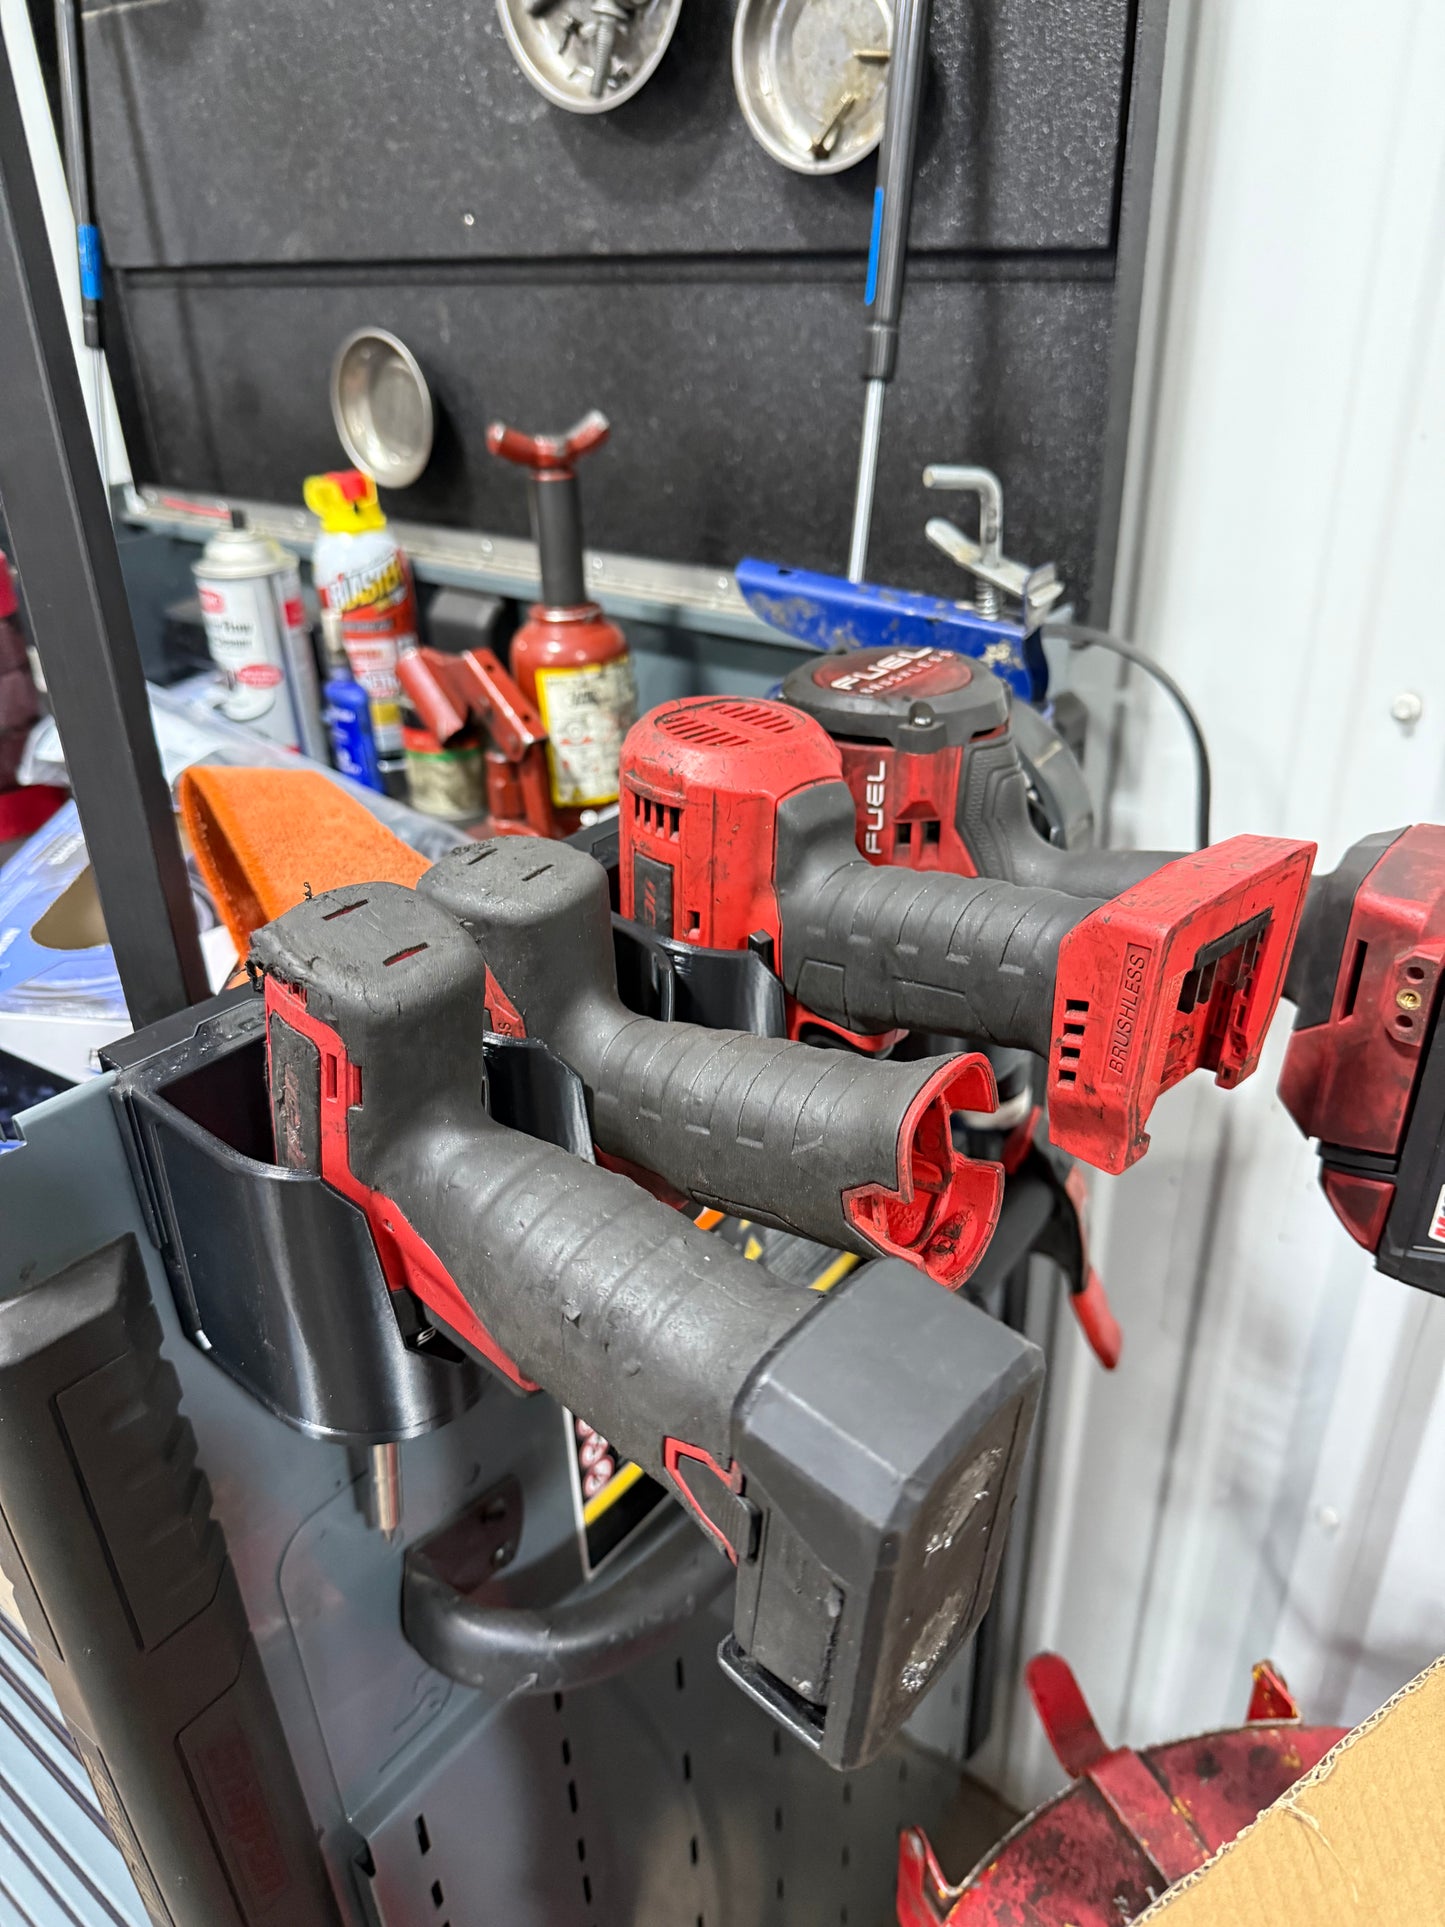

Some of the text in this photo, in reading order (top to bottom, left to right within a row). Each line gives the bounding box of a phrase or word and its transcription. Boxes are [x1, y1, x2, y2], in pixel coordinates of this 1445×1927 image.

[830, 646, 934, 691] FUEL
[859, 650, 954, 694] BRUSHLESS
[864, 759, 887, 855] FUEL
[1108, 953, 1146, 1077] BRUSHLESS
